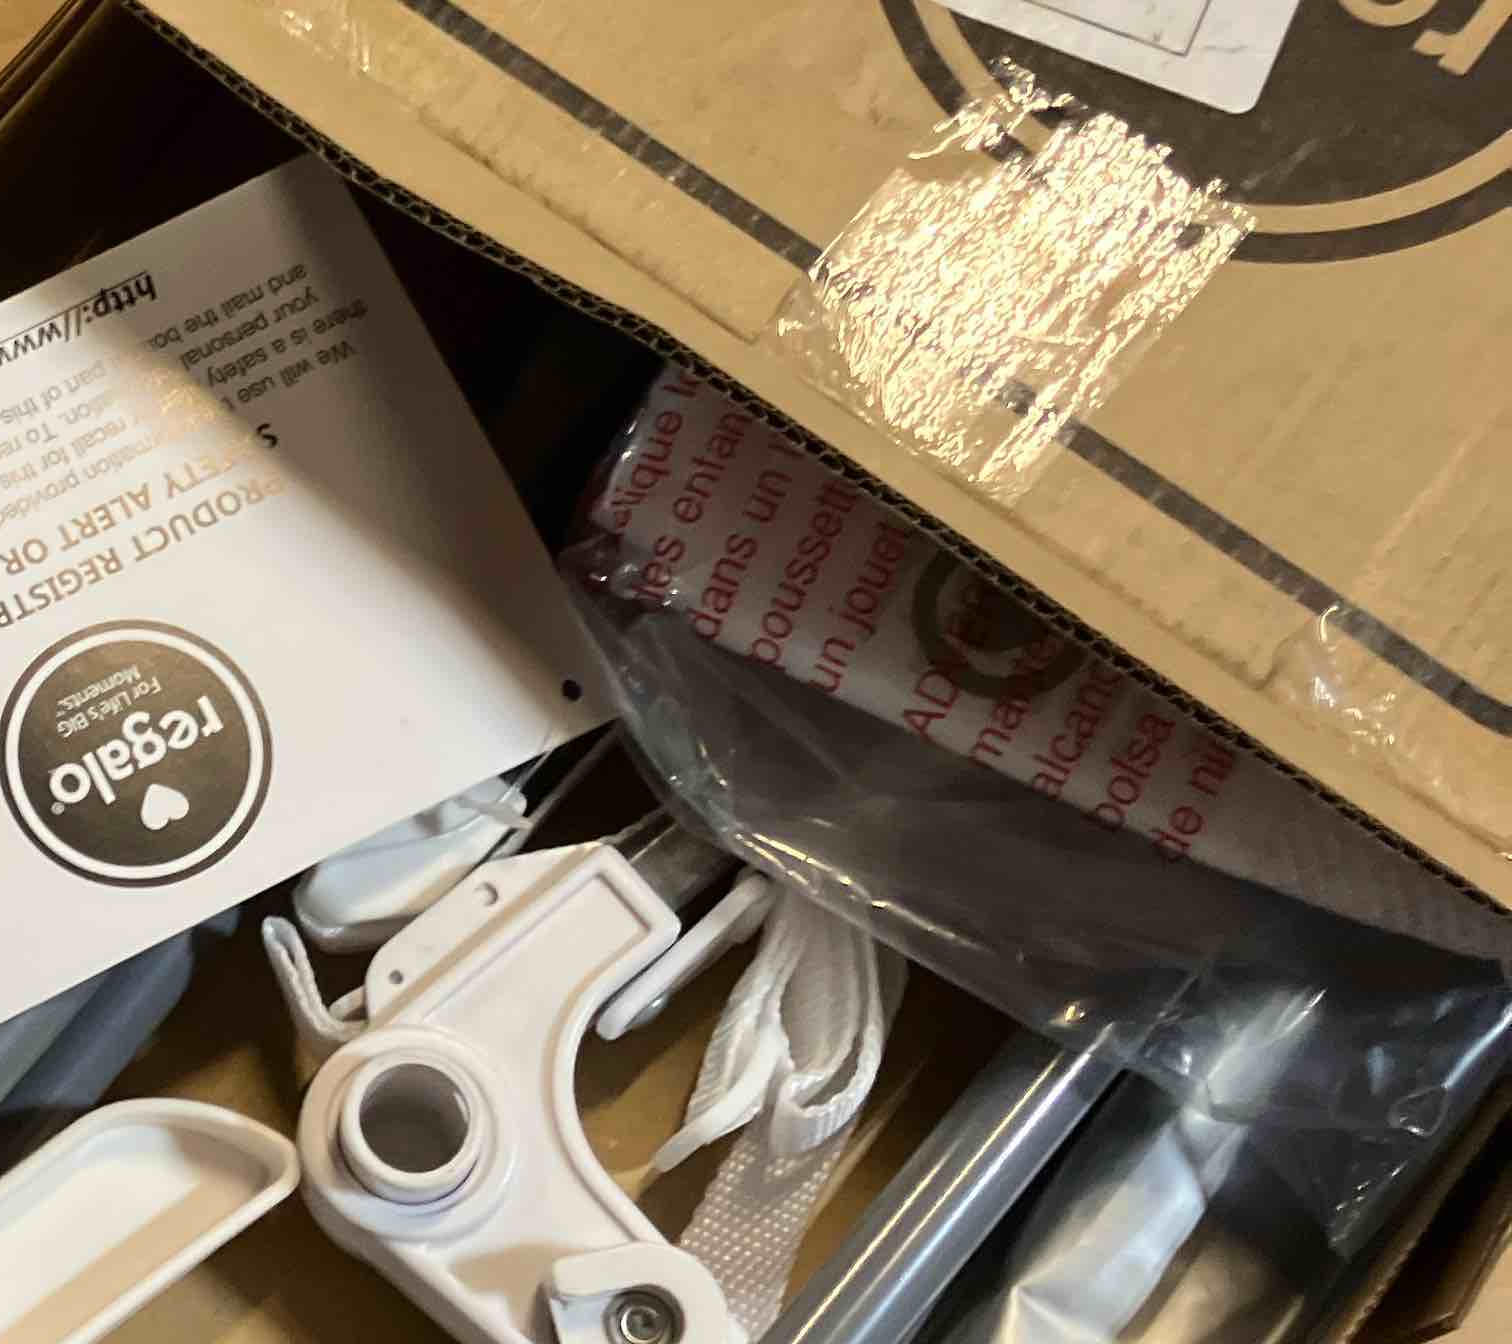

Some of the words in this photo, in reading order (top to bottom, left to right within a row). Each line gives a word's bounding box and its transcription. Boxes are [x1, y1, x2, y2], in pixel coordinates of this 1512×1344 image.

[267, 263, 307, 295] and
[220, 284, 265, 319] mail
[273, 286, 319, 323] your
[183, 308, 219, 333] the
[178, 311, 270, 371] personal
[270, 338, 287, 354] a
[289, 327, 308, 346] is
[316, 340, 354, 366] We
[206, 347, 269, 390] safety
[279, 358, 314, 387] will
[40, 385, 63, 408] of
[236, 376, 276, 404] use
[0, 396, 40, 425] this
[25, 422, 56, 444] To
[68, 415, 129, 458] recall
[40, 447, 70, 471] for
[57, 482, 152, 552] ALERT
[688, 530, 760, 641] dans
[742, 467, 791, 525] un
[809, 633, 855, 695] un
[128, 674, 162, 702] For
[54, 710, 89, 739] BIG
[48, 695, 224, 806] regalo
